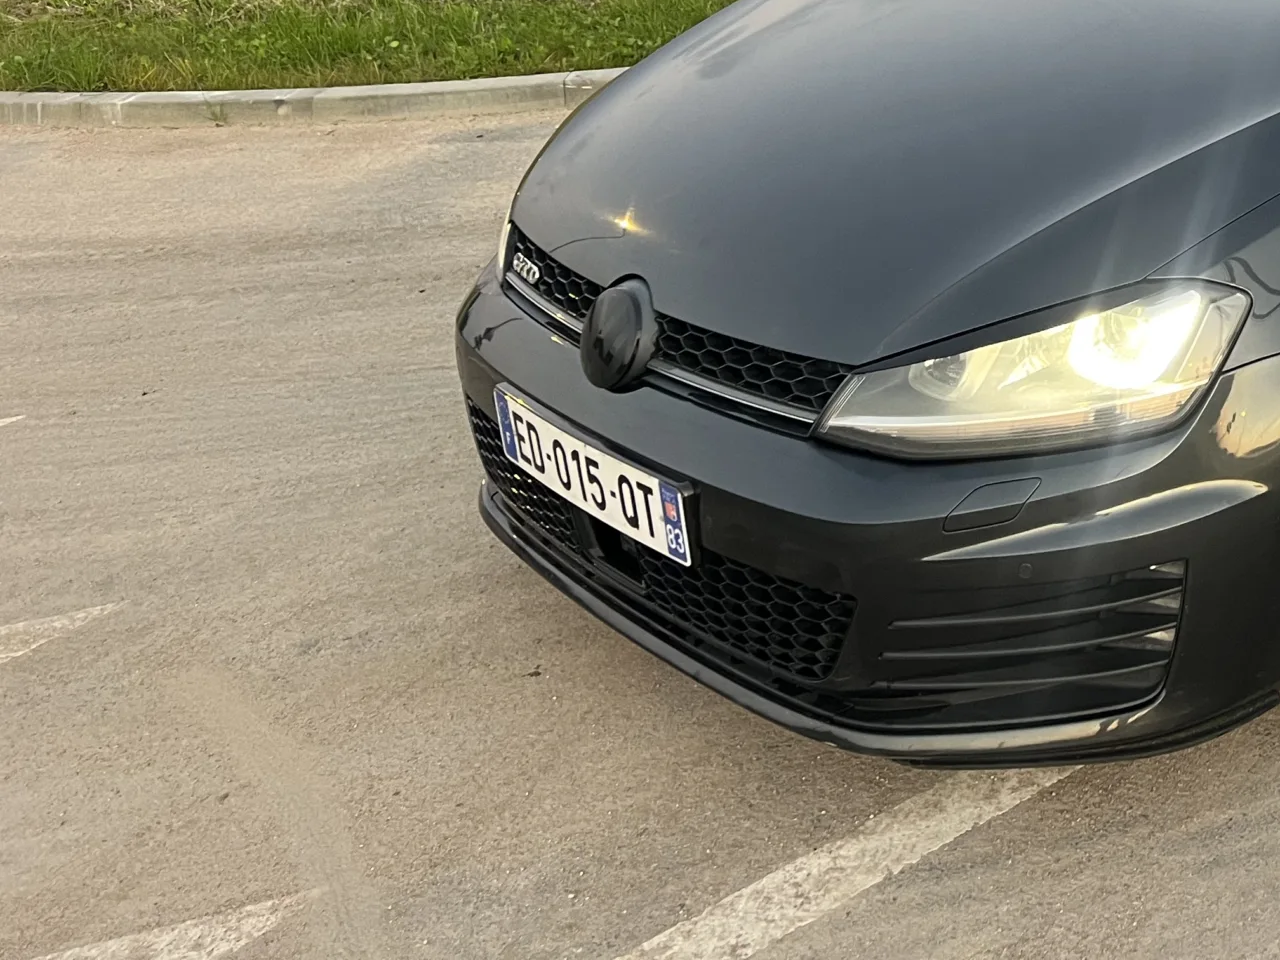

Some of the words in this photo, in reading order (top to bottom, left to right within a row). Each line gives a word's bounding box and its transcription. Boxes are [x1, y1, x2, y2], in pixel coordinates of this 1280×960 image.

[505, 431, 512, 445] F
[512, 411, 655, 538] ED-015-QT
[665, 523, 685, 554] 83
